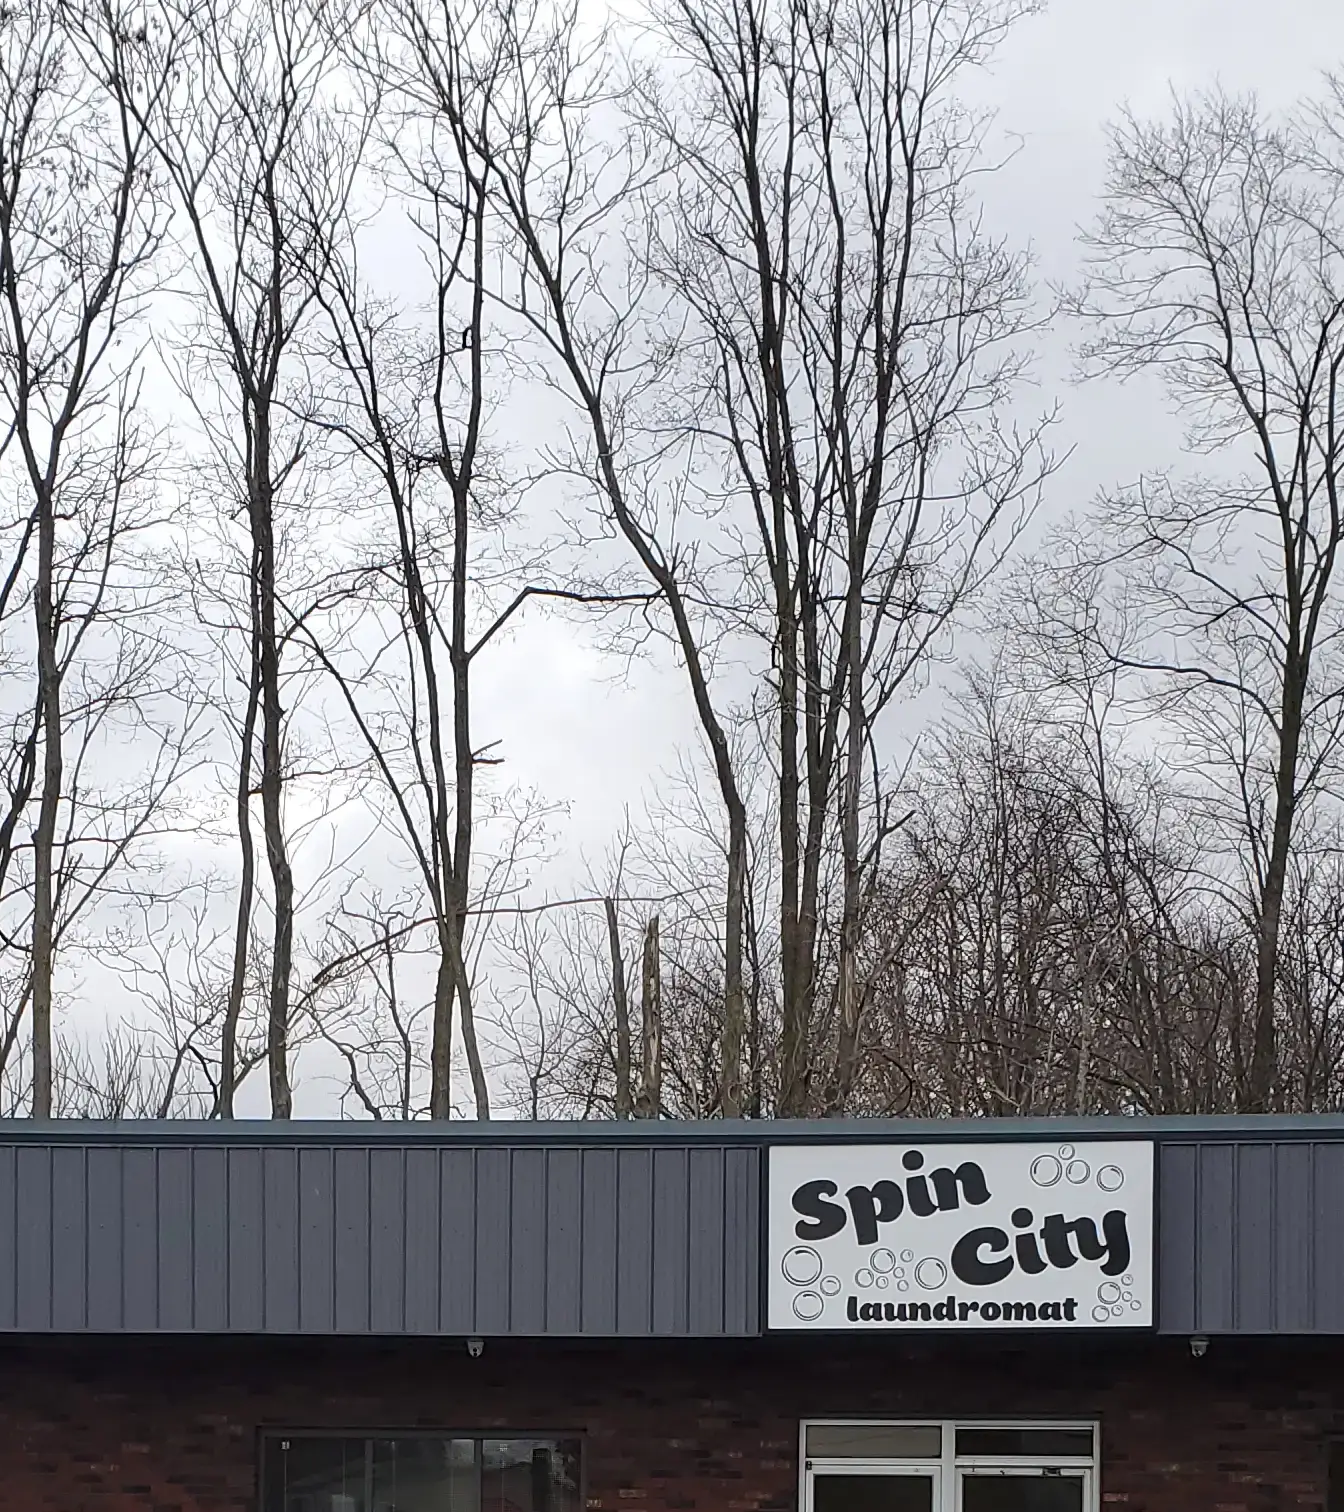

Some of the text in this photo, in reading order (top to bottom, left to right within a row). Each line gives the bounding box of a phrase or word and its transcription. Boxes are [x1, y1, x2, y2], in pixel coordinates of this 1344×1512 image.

[791, 1150, 992, 1246] Spin
[951, 1207, 1131, 1286] City
[846, 1296, 1079, 1322] laundromat
